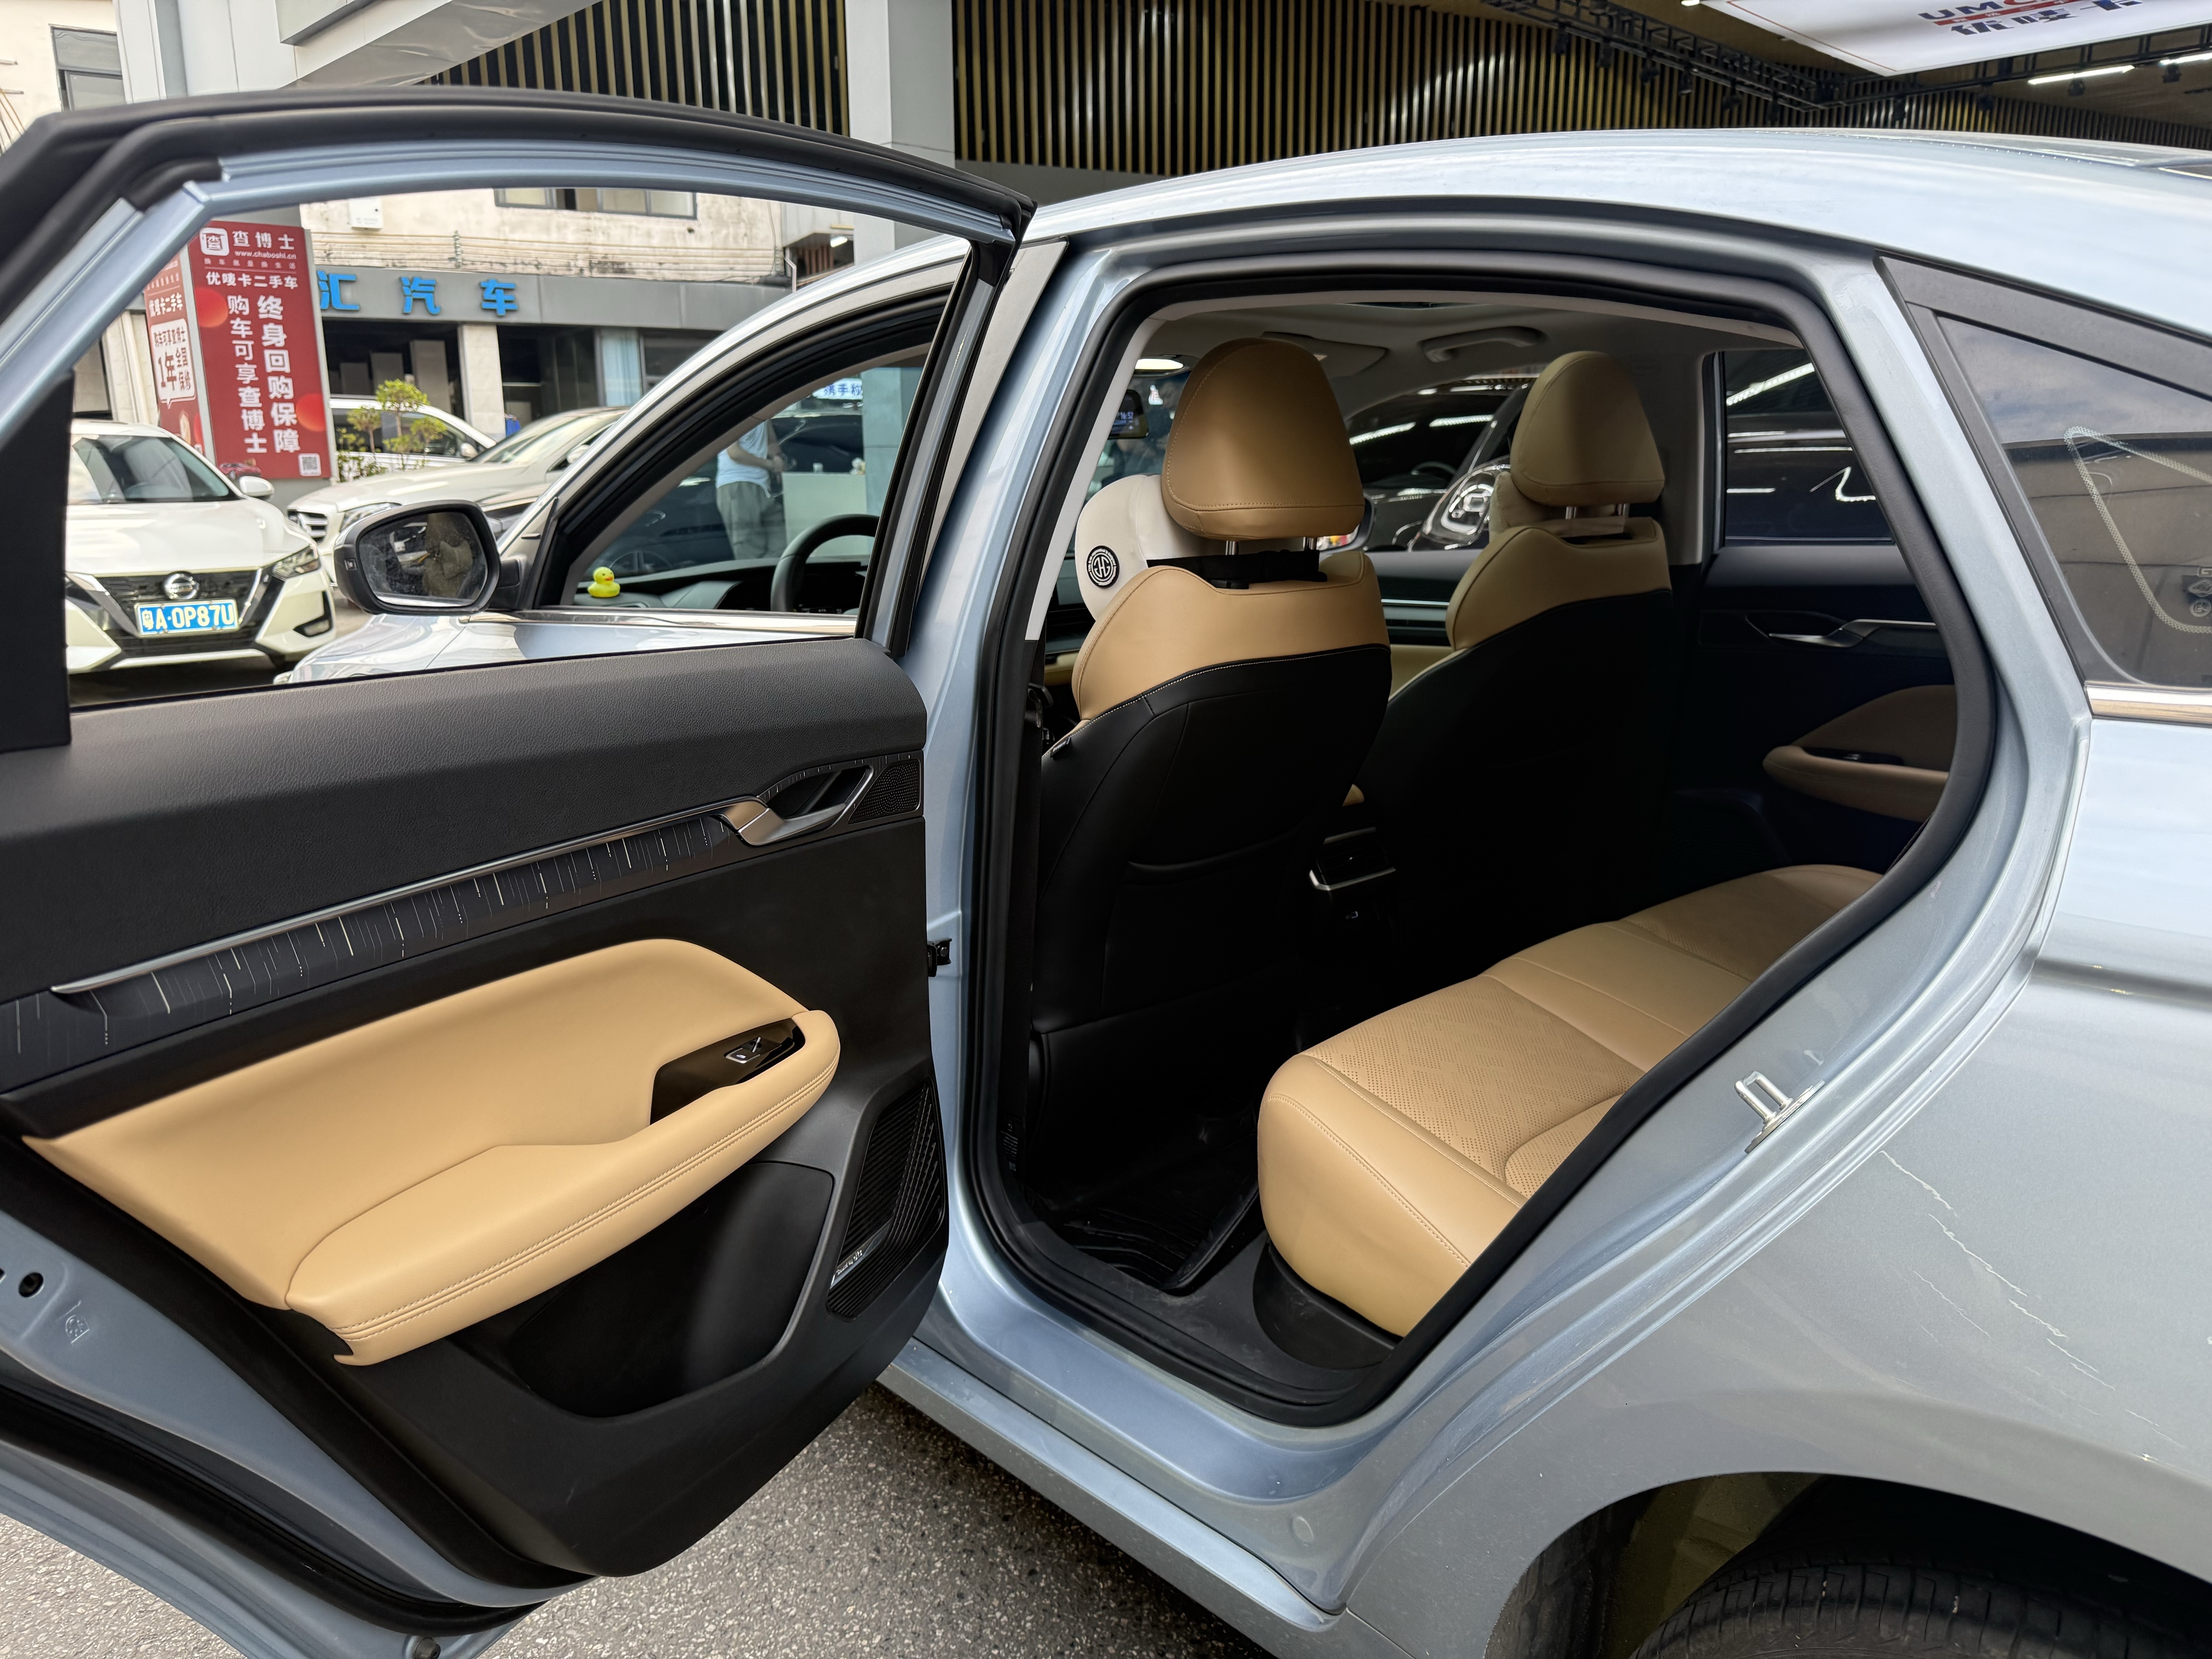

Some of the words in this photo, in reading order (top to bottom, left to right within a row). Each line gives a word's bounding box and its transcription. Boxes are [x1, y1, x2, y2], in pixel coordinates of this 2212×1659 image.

[232, 230, 294, 250] 查博士
[206, 271, 298, 290] 优唛卡二手车
[316, 270, 519, 316] 汇汽车
[227, 295, 267, 453] 购车可享查博士
[257, 295, 301, 453] 终身回购保障
